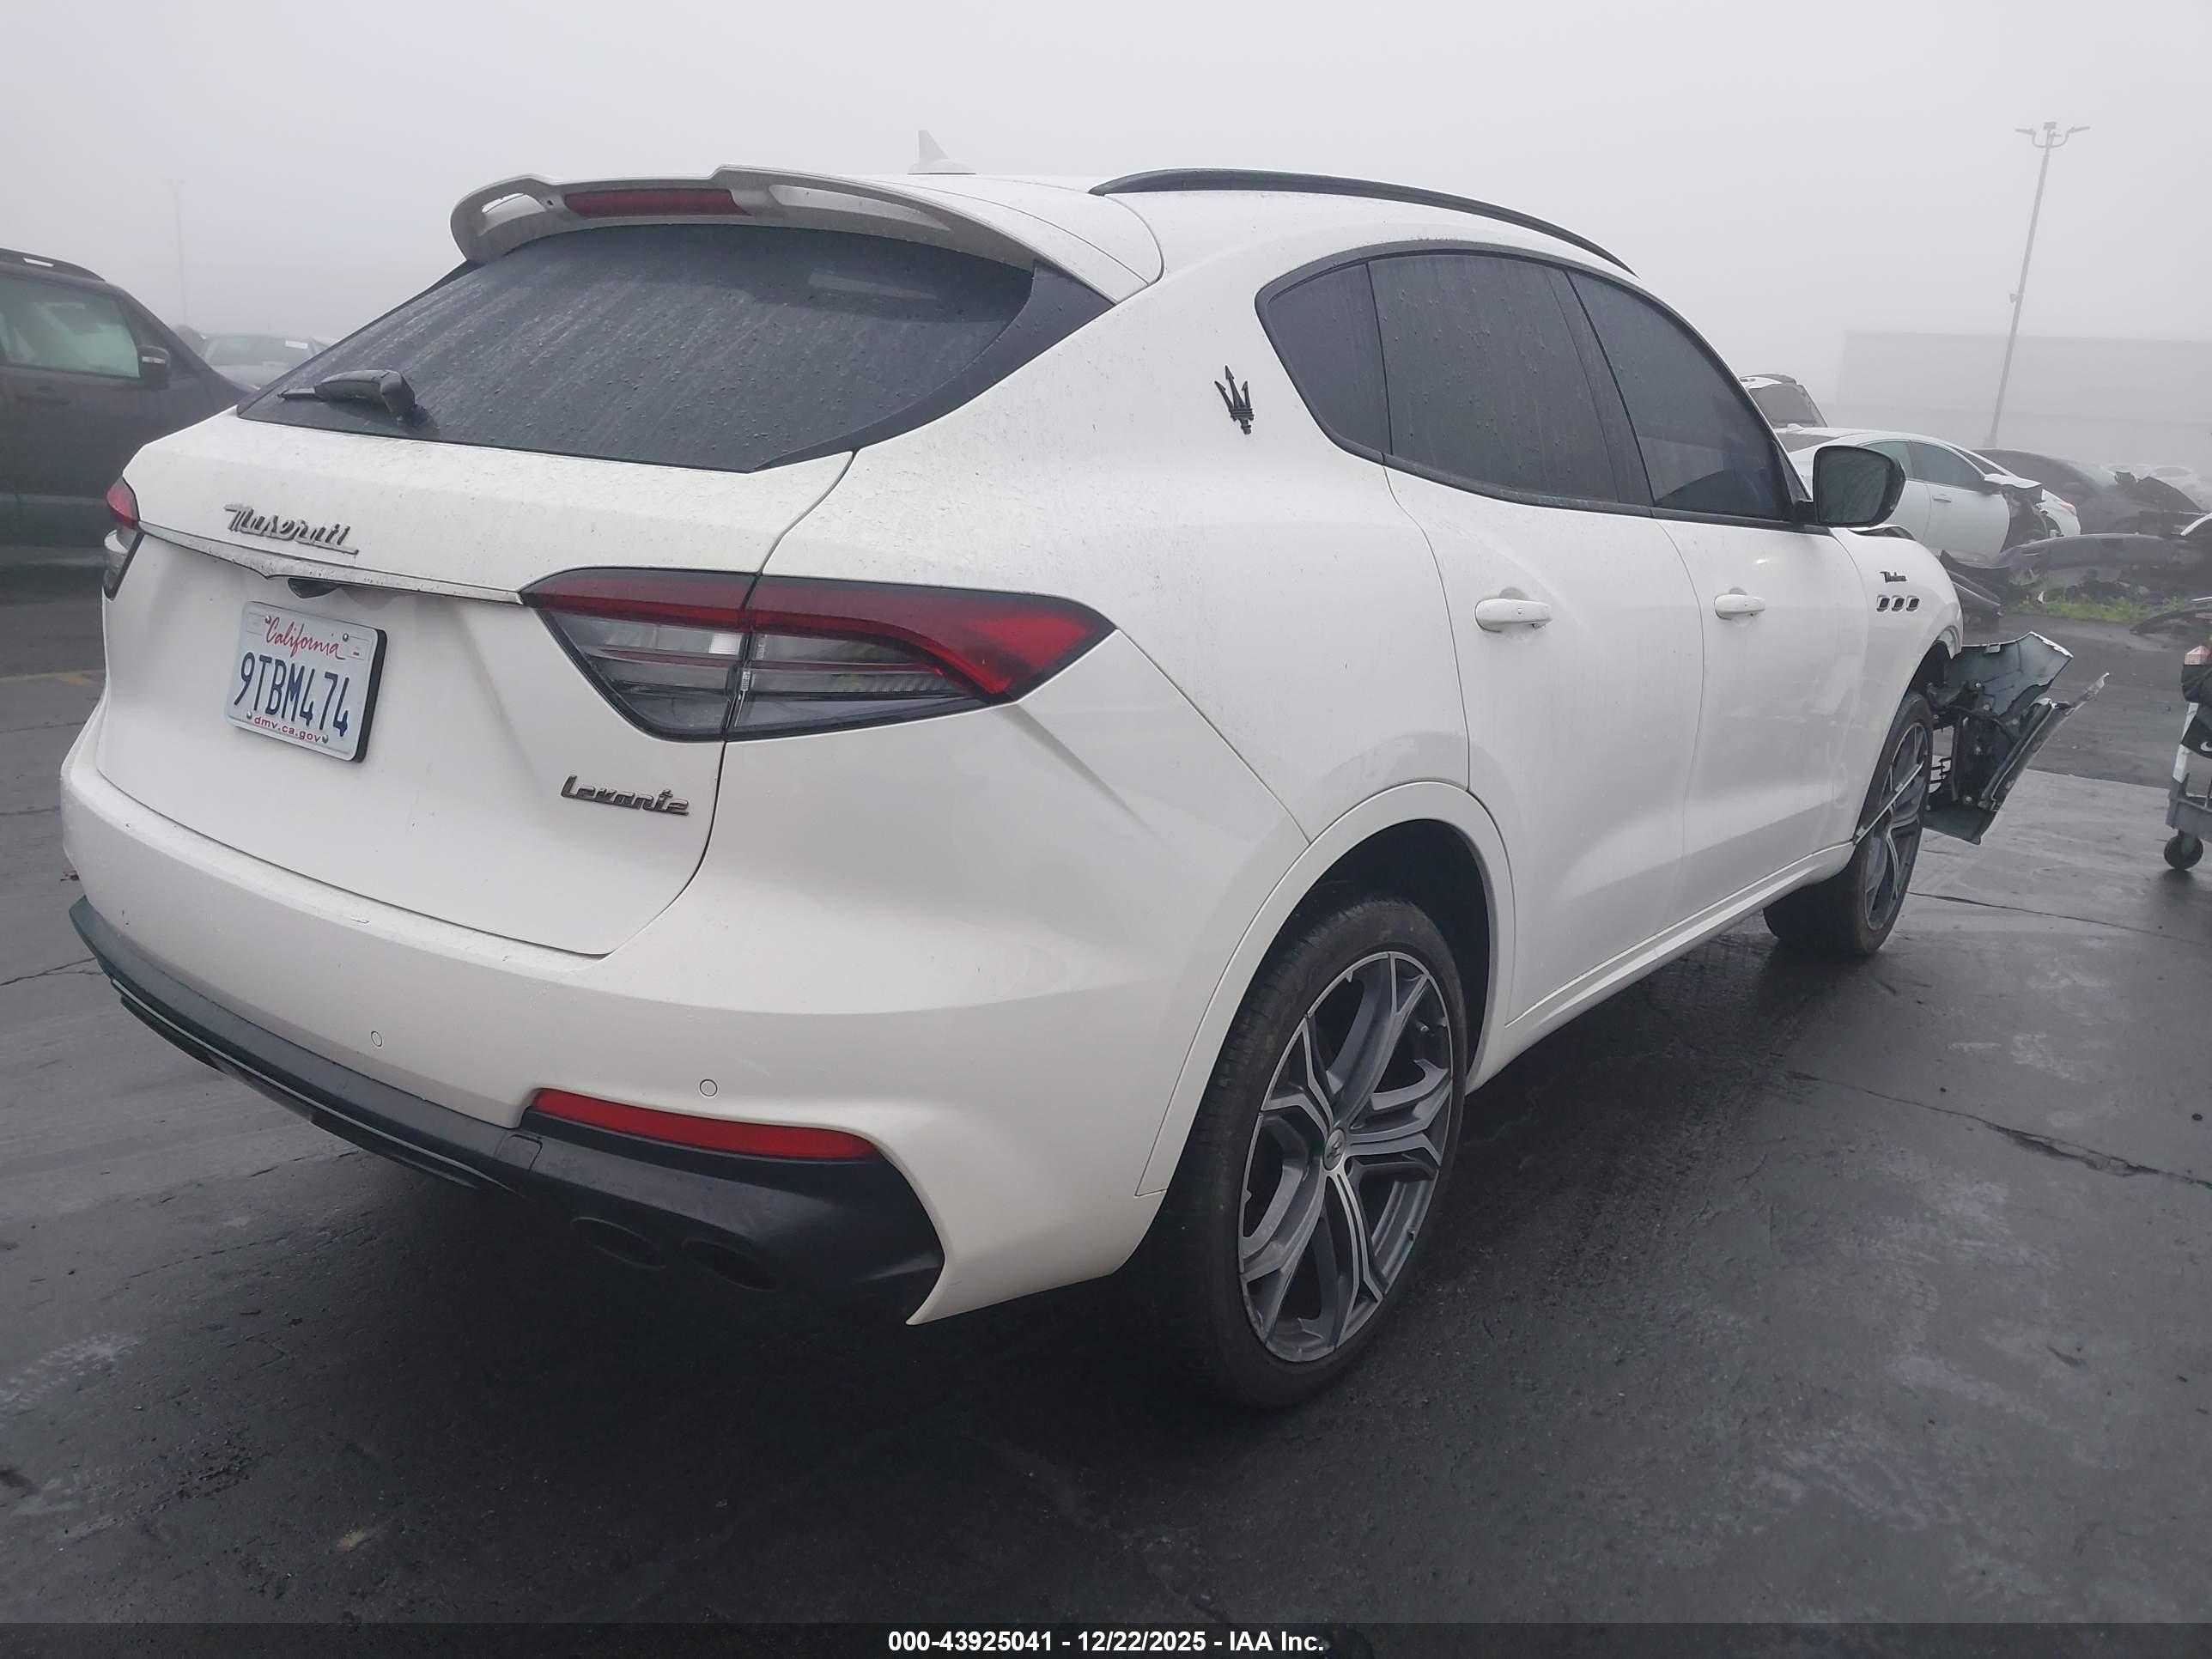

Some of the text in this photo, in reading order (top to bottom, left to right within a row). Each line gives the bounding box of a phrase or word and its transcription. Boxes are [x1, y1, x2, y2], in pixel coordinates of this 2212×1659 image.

[223, 503, 359, 555] Maserati
[265, 617, 345, 659] California
[234, 651, 350, 737] 9TBM474
[254, 716, 321, 743] dmv.ca.gov
[561, 774, 690, 816] Levante
